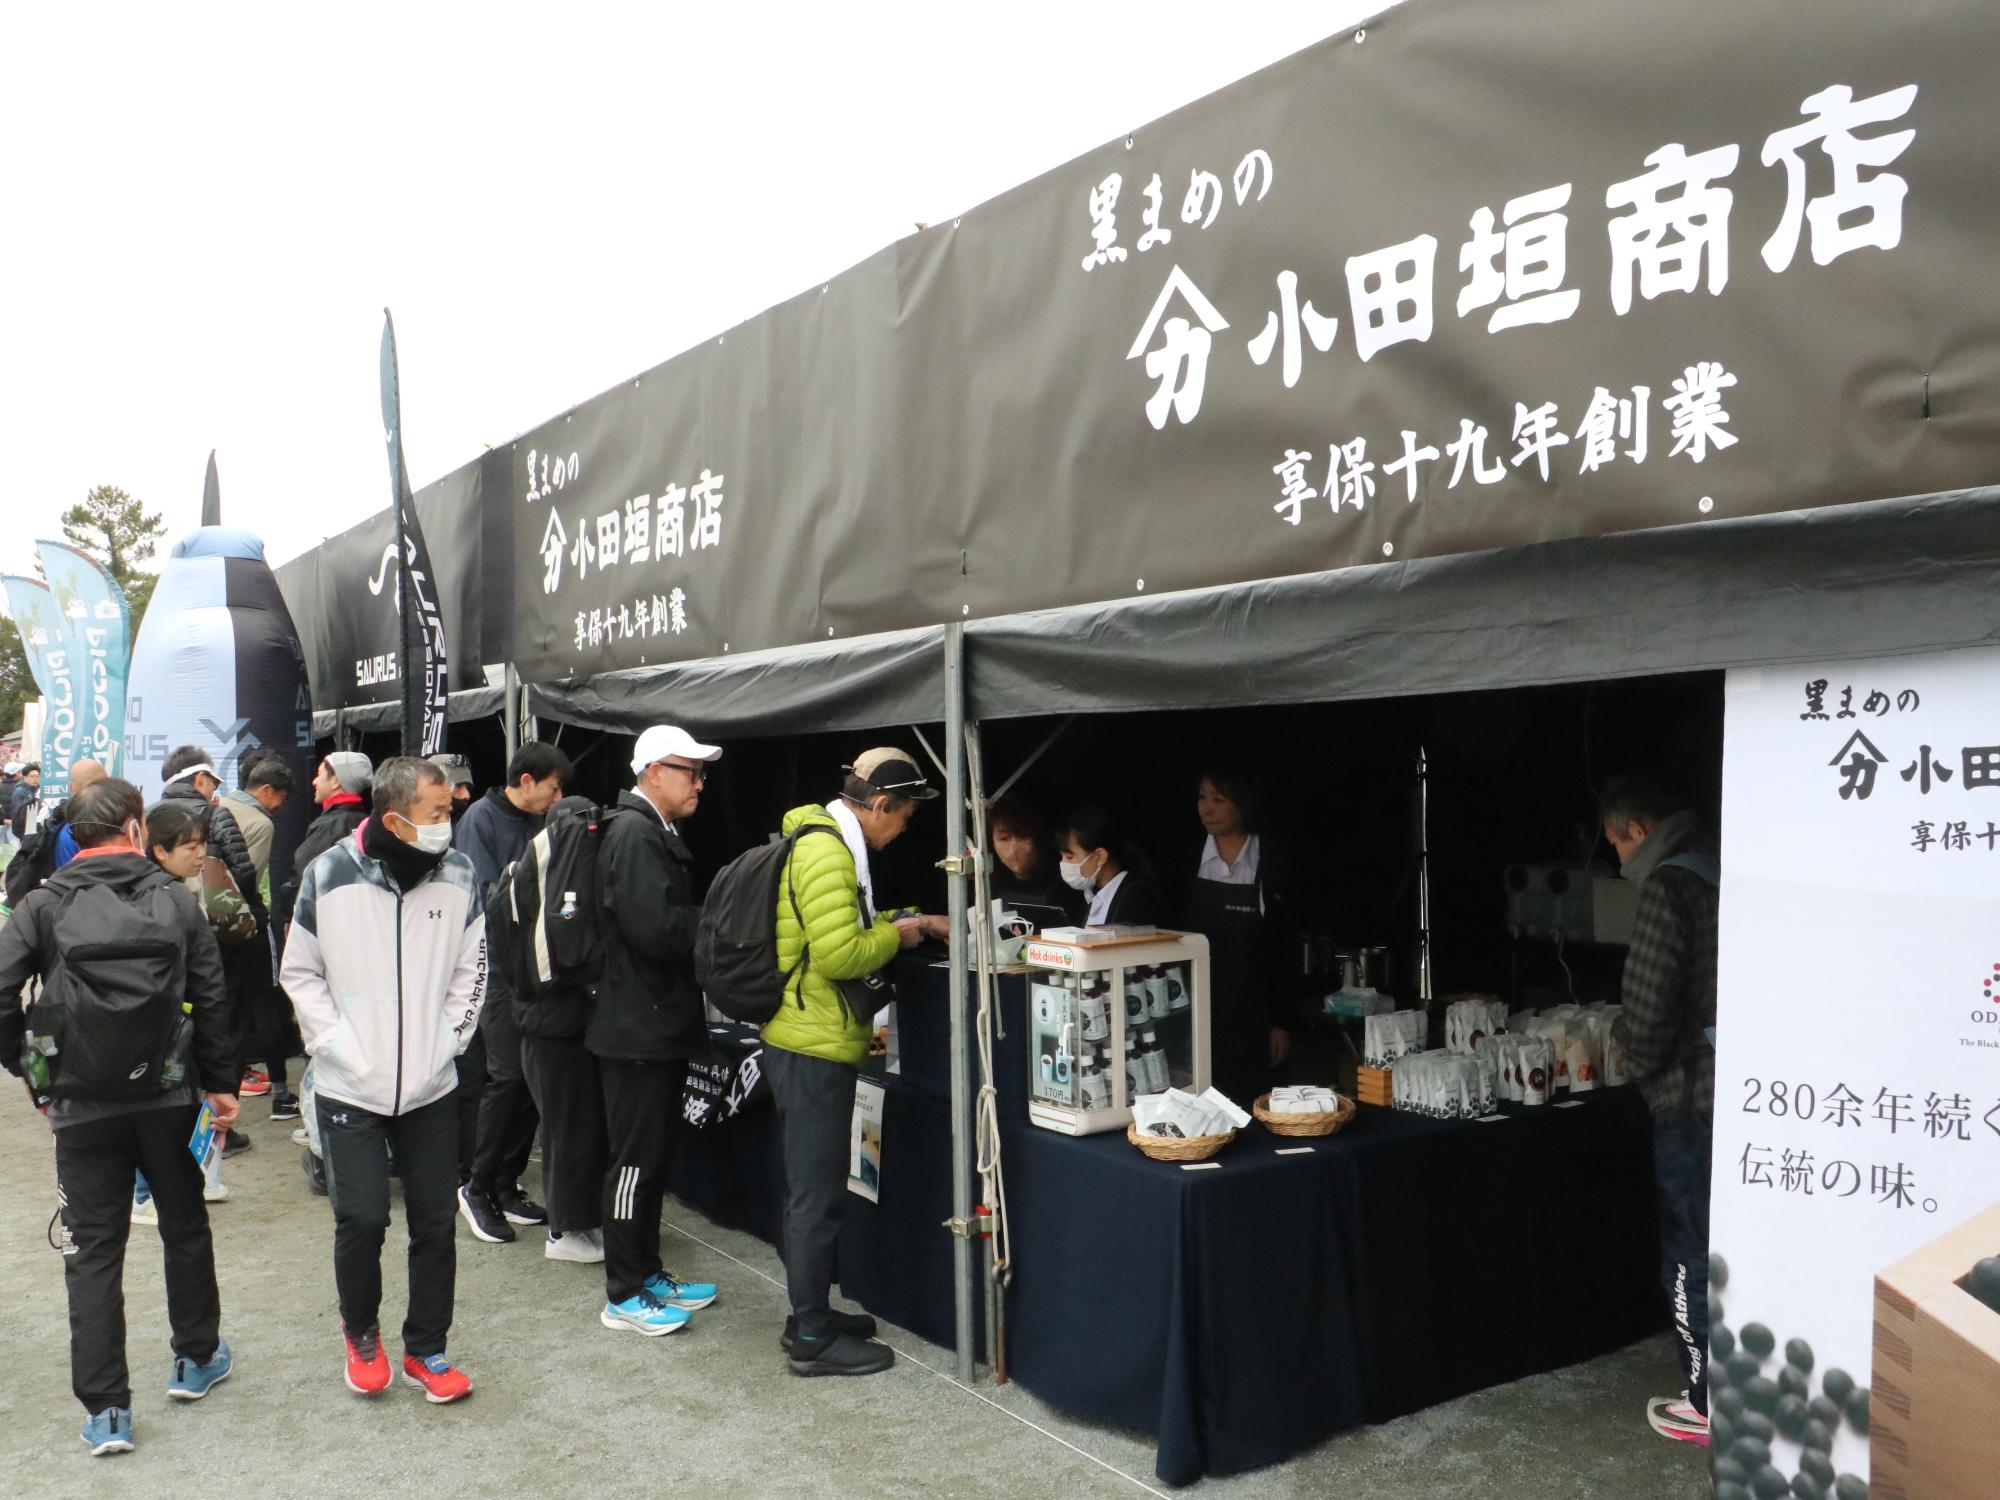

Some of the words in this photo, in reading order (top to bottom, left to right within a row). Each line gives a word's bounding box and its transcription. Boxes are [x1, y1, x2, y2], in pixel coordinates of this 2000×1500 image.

[1082, 148, 1274, 272] 黒まめの
[1247, 83, 1919, 389] 小田垣商店
[1271, 361, 1740, 526] 享保十九年創業
[526, 448, 580, 502] 黒まめの
[570, 468, 725, 580] 小田垣商店
[574, 586, 689, 651] 享保十九年創業
[356, 652, 397, 687] SAURUS
[1799, 678, 1921, 721] 黒まめの
[469, 938, 487, 1008] ARMOUR
[1029, 947, 1042, 961] Hot
[1042, 950, 1063, 964] drinks
[1958, 1037, 1975, 1047] The
[1977, 1039, 2000, 1049] Black
[1970, 1010, 2000, 1024] OD
[1738, 1141, 1939, 1214] 伝統の味。
[1676, 1323, 1695, 1344] of
